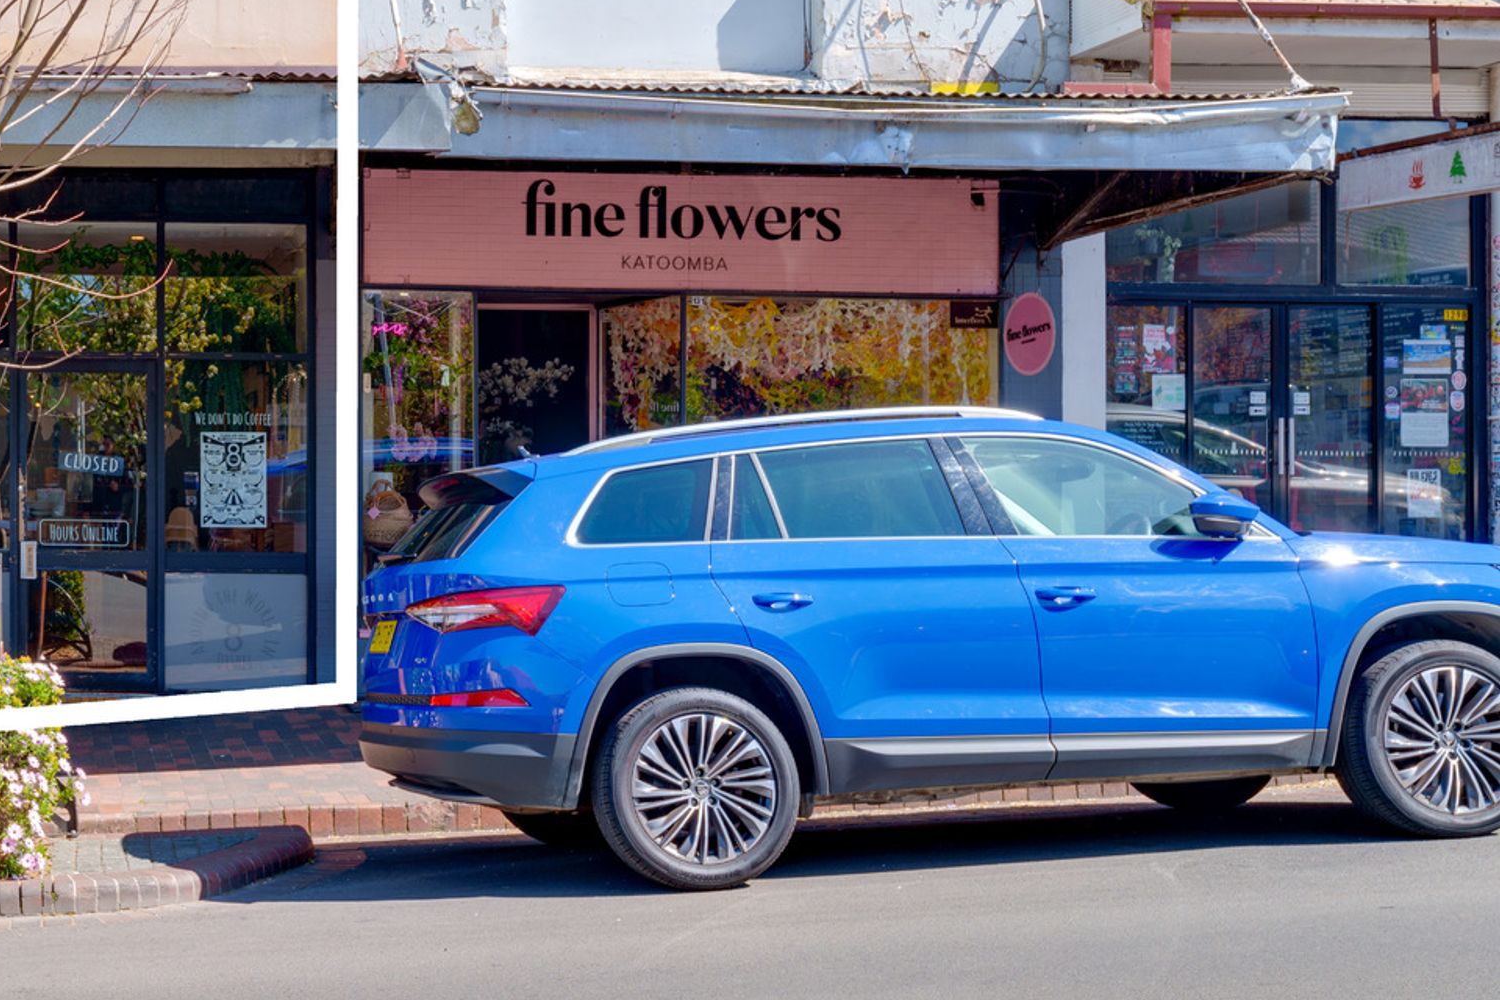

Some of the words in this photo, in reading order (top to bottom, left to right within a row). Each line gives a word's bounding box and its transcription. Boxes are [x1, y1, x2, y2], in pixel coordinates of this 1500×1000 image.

[521, 179, 626, 238] fine
[636, 186, 842, 242] flowers
[621, 255, 729, 272] KATOOMBA
[194, 410, 206, 426] WE
[232, 412, 243, 426] DO
[244, 410, 272, 426] COFFEE
[63, 452, 119, 474] CLOSED
[50, 524, 79, 542] HOURS
[82, 523, 119, 542] ONLINE
